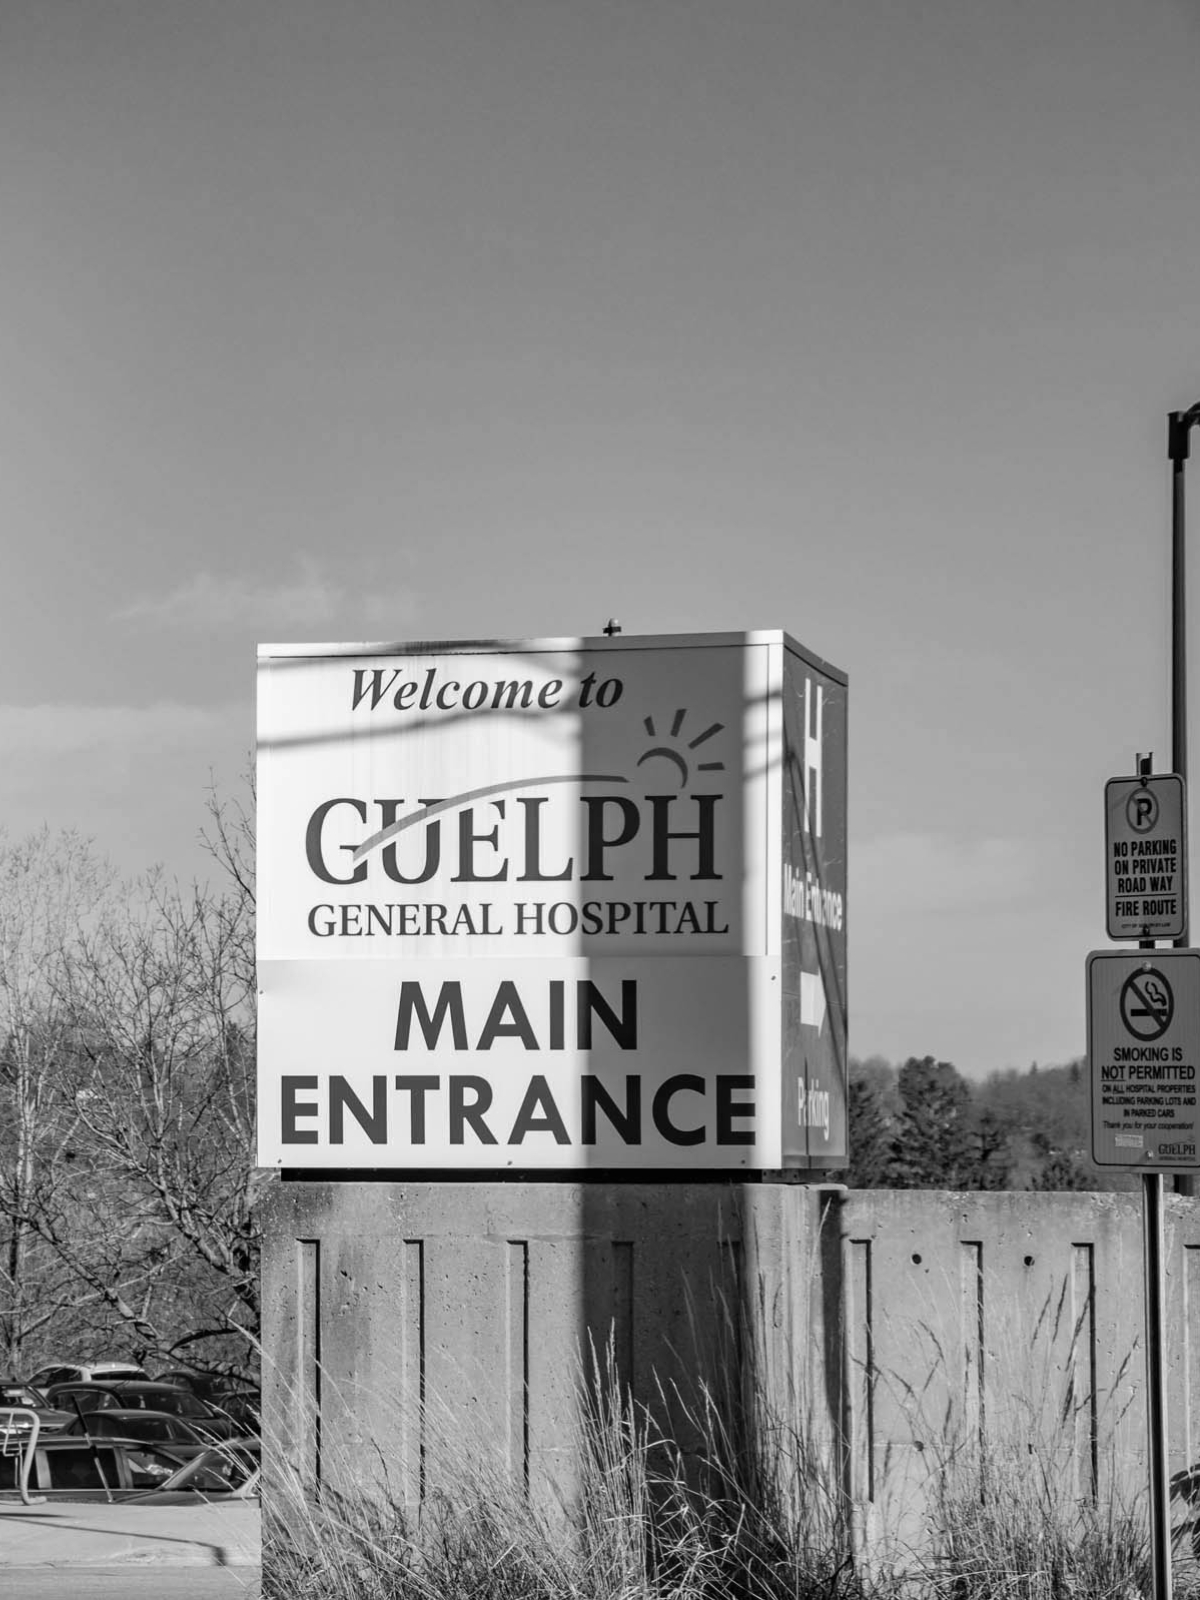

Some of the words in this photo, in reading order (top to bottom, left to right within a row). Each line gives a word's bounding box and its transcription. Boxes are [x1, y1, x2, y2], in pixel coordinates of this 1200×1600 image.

[350, 667, 564, 712] Welcome
[579, 671, 624, 709] to
[804, 678, 823, 838] H
[305, 794, 724, 885] GUELPH
[1114, 841, 1128, 857] NO
[1131, 839, 1177, 856] PARKING
[1114, 860, 1129, 875] ON
[1133, 857, 1176, 874] PRIVATE
[1118, 877, 1146, 893] ROAD
[1150, 876, 1173, 891] WAY
[1115, 901, 1139, 916] FIRE
[1143, 899, 1177, 916] ROUTE
[308, 903, 503, 937] GENERAL
[514, 901, 729, 935] HOSPITAL
[394, 980, 638, 1051] MAIN
[1114, 1047, 1169, 1061] SMOKING
[1172, 1047, 1183, 1061] IS
[1102, 1065, 1126, 1080] NOT
[1129, 1065, 1195, 1080] PERMITTED
[1102, 1084, 1111, 1093] ON
[1126, 1084, 1155, 1093] HOSPITAL
[1157, 1084, 1195, 1093] PROPERTIES
[1102, 1097, 1135, 1105] INCLUDING
[1137, 1097, 1164, 1105] PARKING
[1183, 1097, 1196, 1105] AND
[281, 1074, 756, 1146] ENTRANCE
[1131, 1109, 1156, 1117] PARKED
[1158, 1109, 1175, 1117] CARS
[1158, 1144, 1195, 1155] GUELPH
